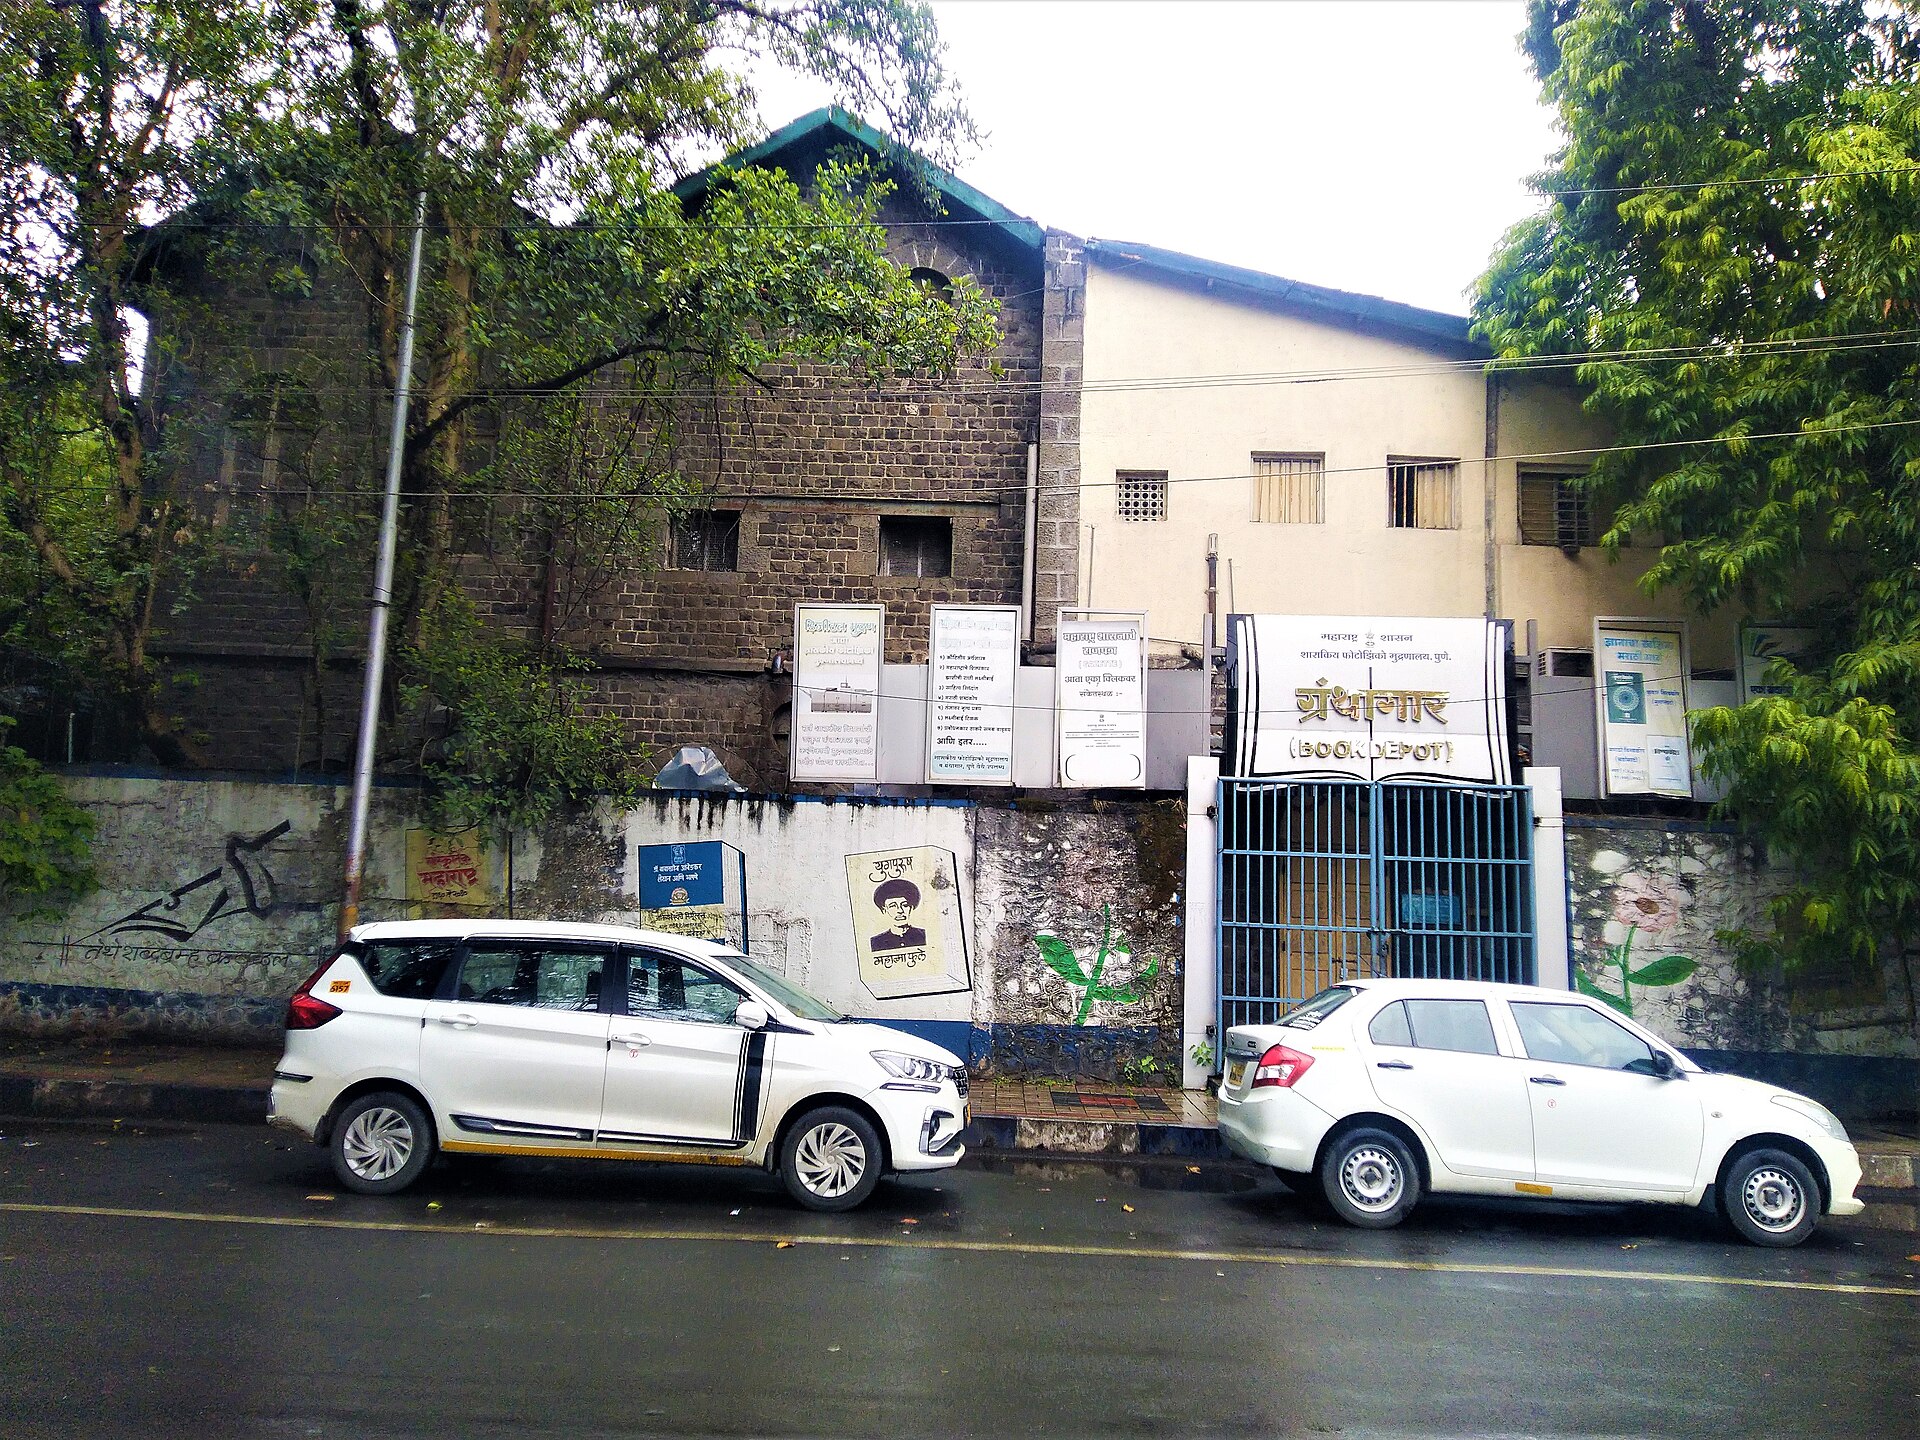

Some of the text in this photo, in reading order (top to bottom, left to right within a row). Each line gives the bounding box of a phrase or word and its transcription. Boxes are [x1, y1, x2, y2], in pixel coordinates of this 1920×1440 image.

[1320, 633, 1358, 642] महाराष्ट्र
[1064, 675, 1083, 683] आता
[1295, 677, 1451, 725] ग्रंथागार
[937, 735, 956, 745] आणि
[906, 948, 926, 968] फुले
[330, 985, 350, 993] 6157
